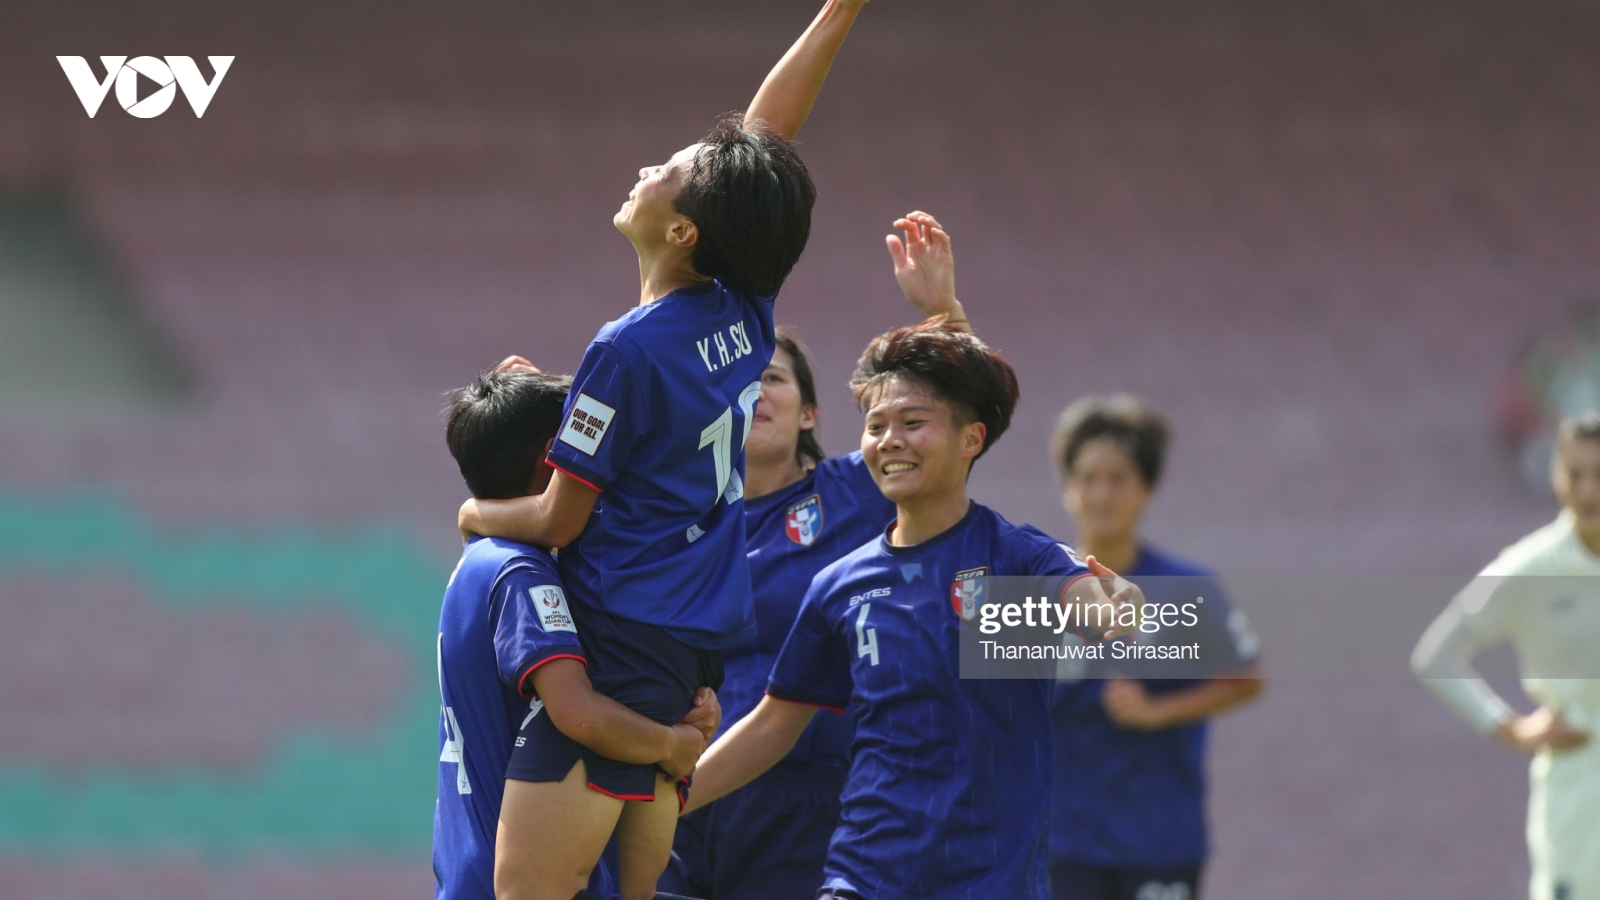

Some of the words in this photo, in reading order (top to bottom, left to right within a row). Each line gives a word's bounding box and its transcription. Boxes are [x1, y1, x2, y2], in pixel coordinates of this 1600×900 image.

[570, 419, 585, 433] FOR
[583, 426, 598, 440] ALL
[573, 408, 588, 422] OUR
[586, 415, 606, 432] GOAL
[856, 603, 880, 667] 4
